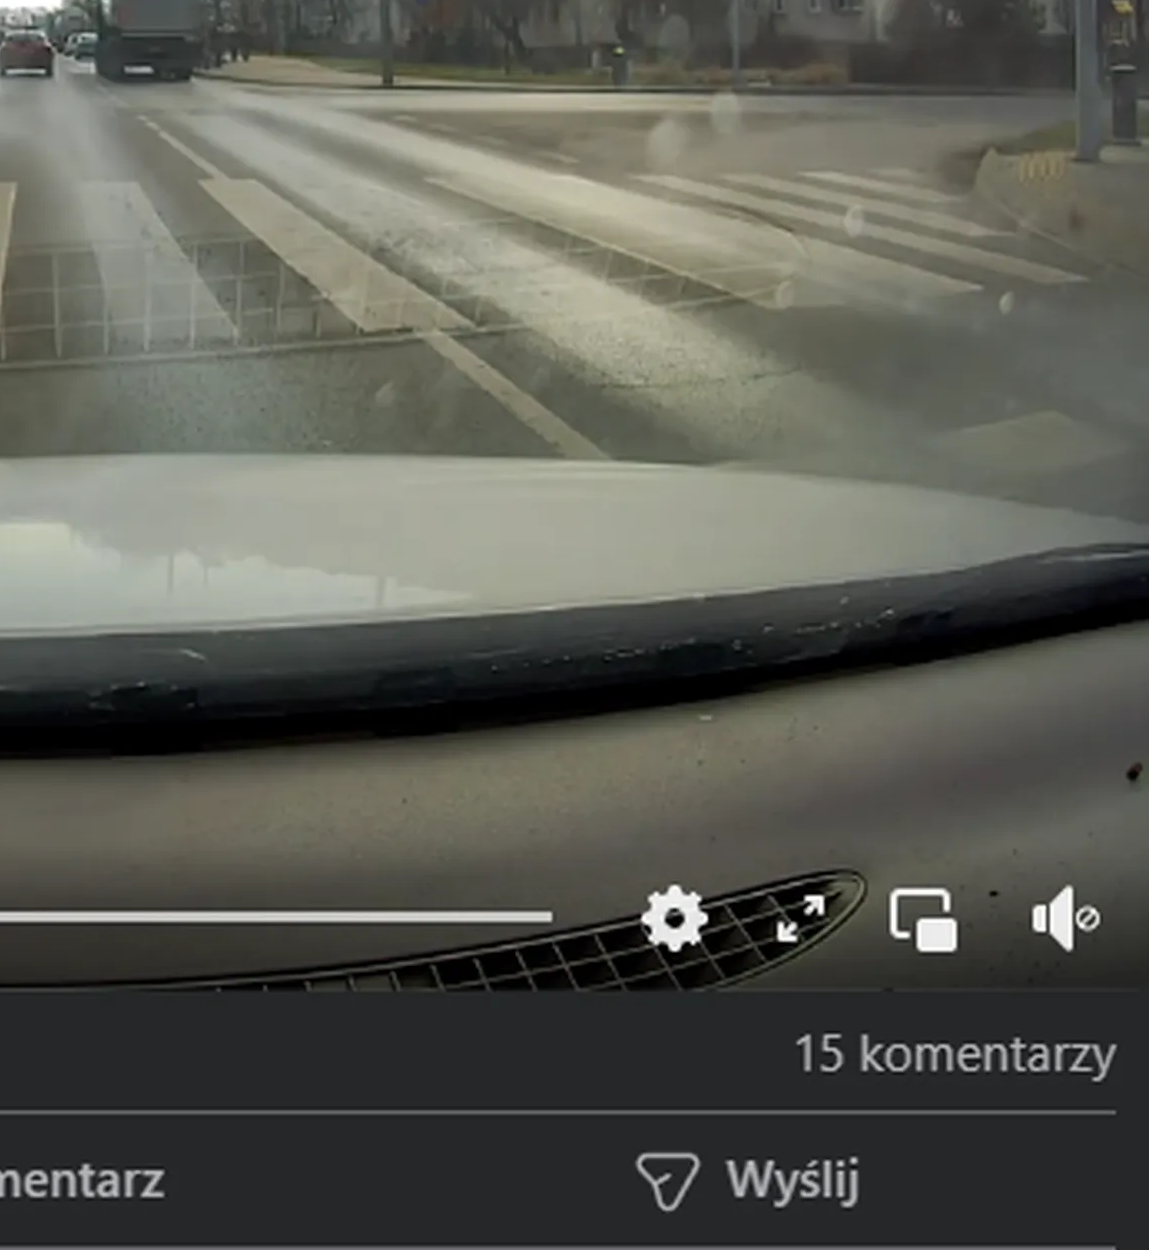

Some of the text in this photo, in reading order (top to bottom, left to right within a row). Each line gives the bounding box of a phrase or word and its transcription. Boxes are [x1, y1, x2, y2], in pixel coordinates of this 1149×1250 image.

[797, 1034, 1117, 1082] 15 komentarzy
[726, 1157, 858, 1208] Wyślij
